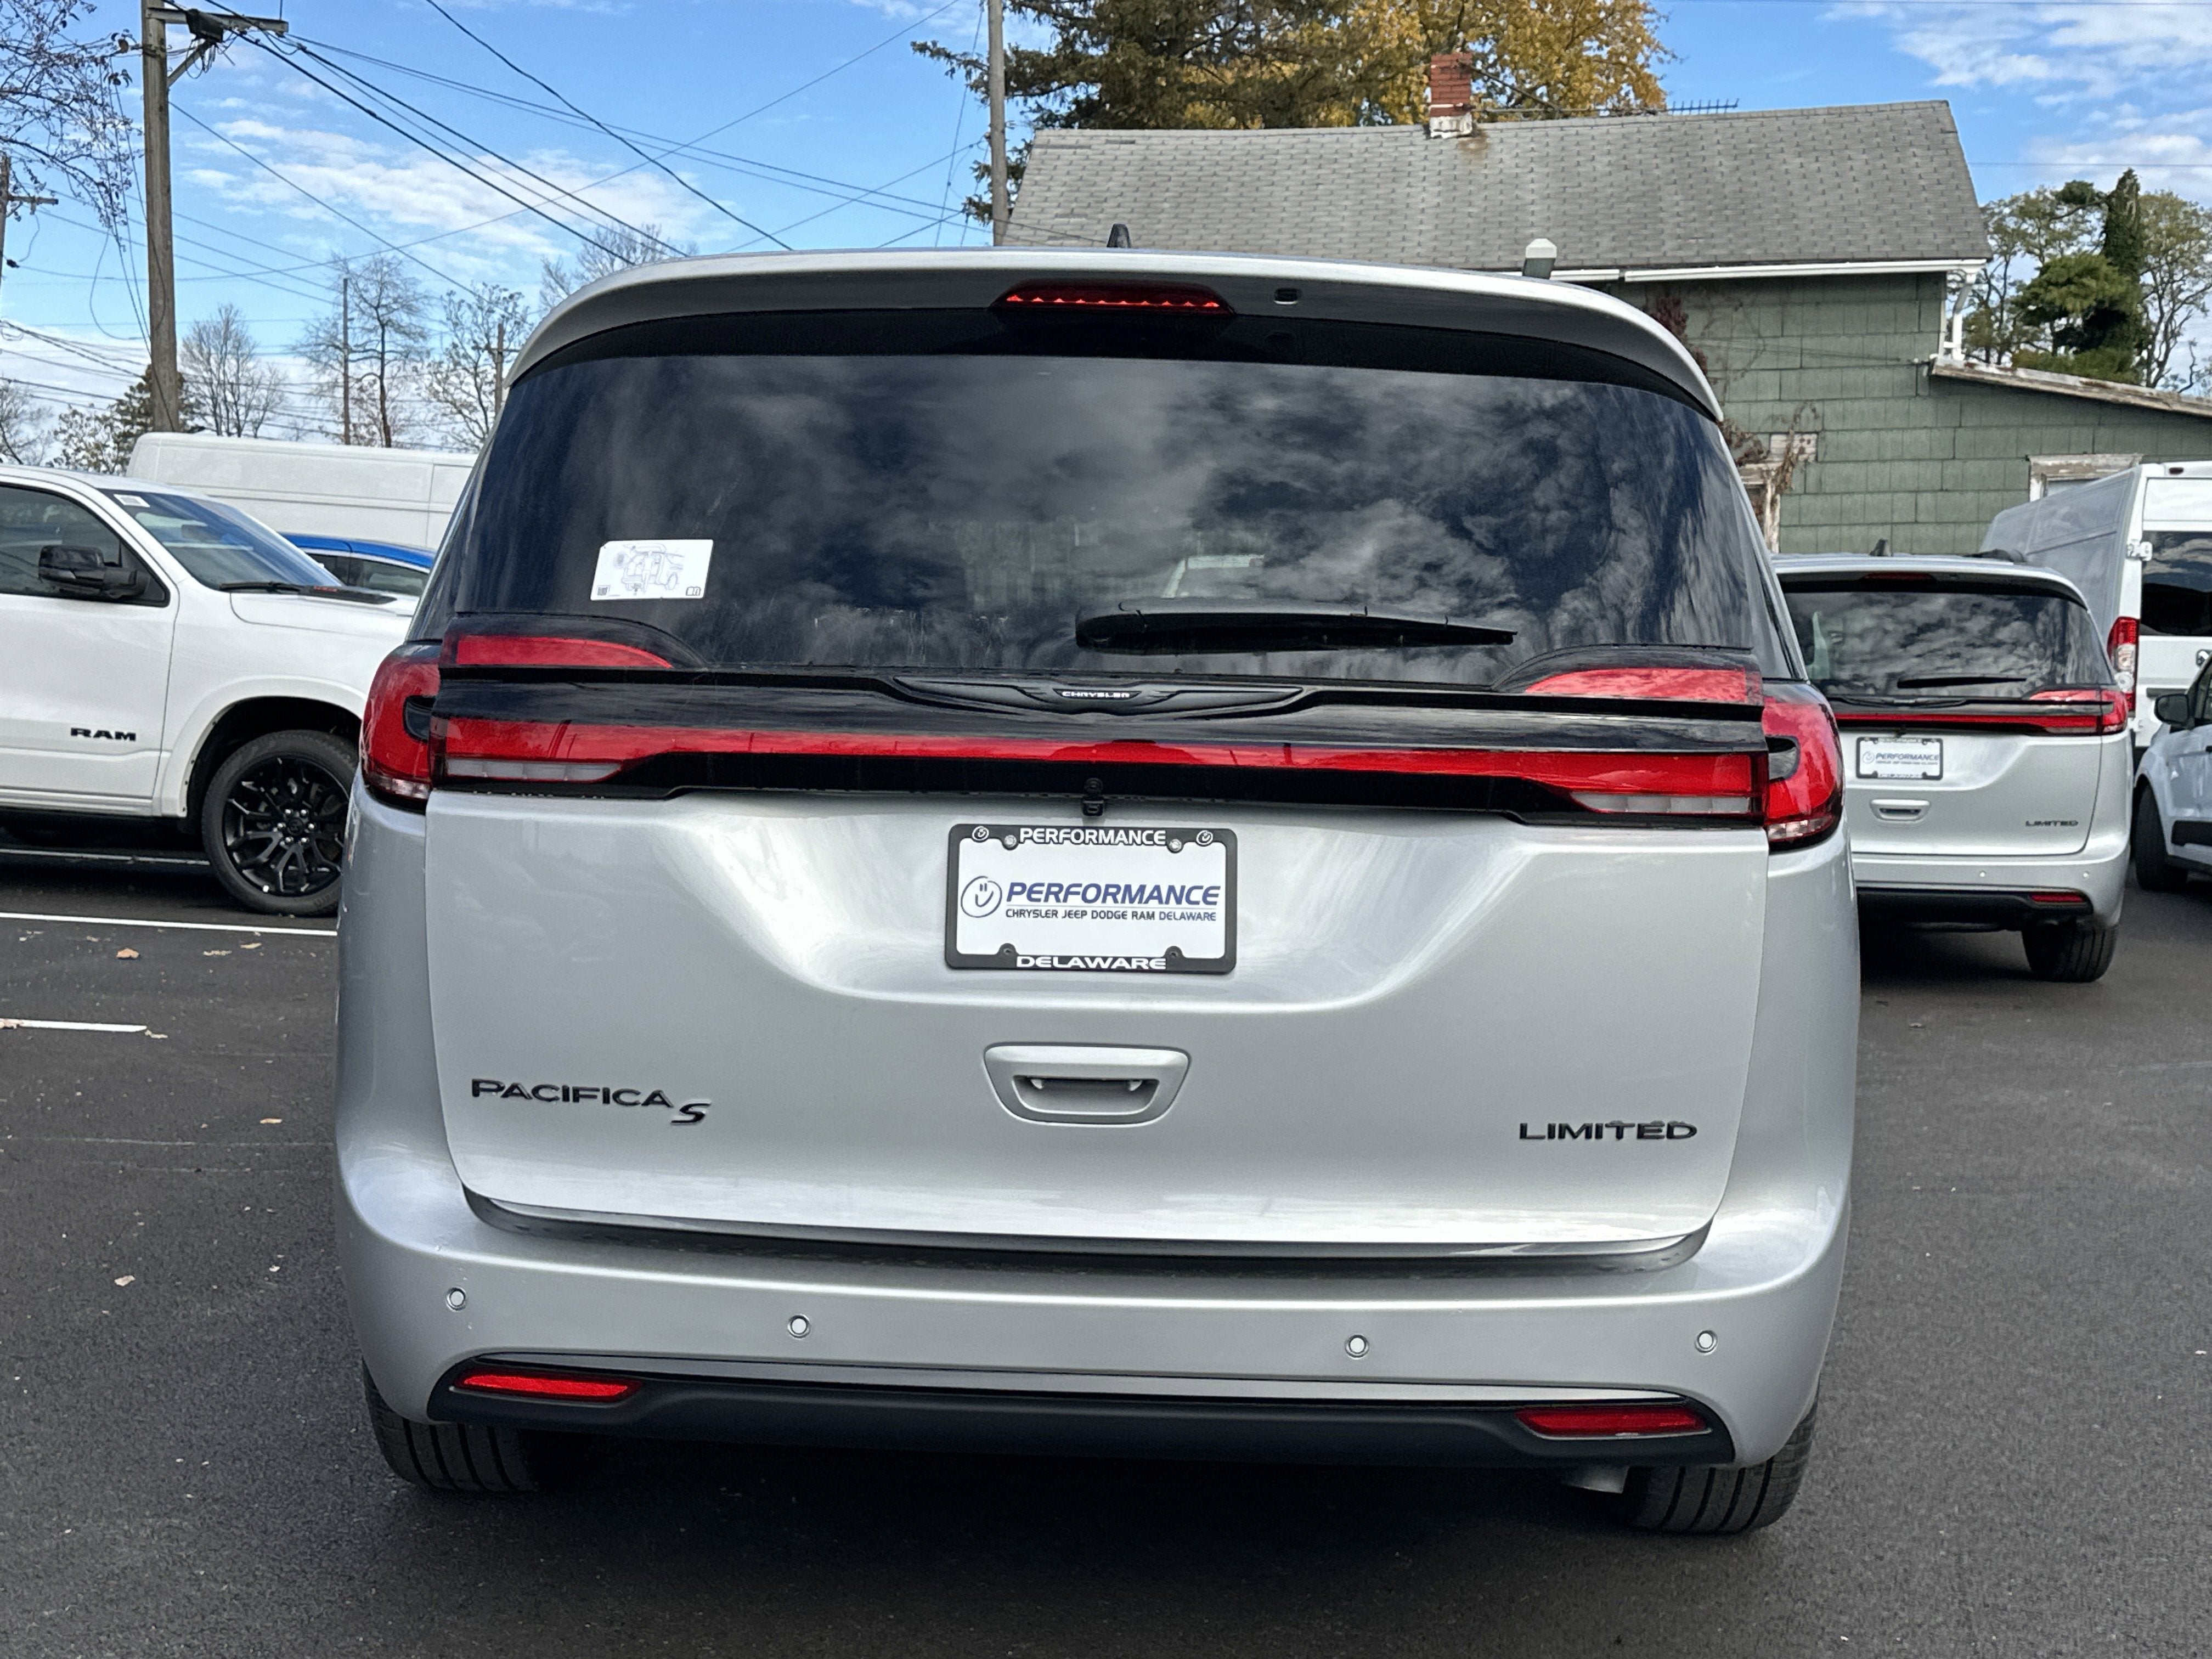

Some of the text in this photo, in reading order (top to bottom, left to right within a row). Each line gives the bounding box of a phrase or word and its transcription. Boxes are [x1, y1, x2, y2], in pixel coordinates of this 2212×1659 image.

[70, 727, 136, 742] RAM
[1019, 827, 1166, 845] PERFORMANCE
[1006, 882, 1221, 906] PERFORMANCE
[1006, 909, 1217, 922] CHRYSLER JEEP DODGE RAM DELAWARE
[1016, 956, 1166, 970] DELAWARE
[471, 1078, 712, 1126] PACIFICA S
[1519, 1122, 1698, 1140] LIMITED
